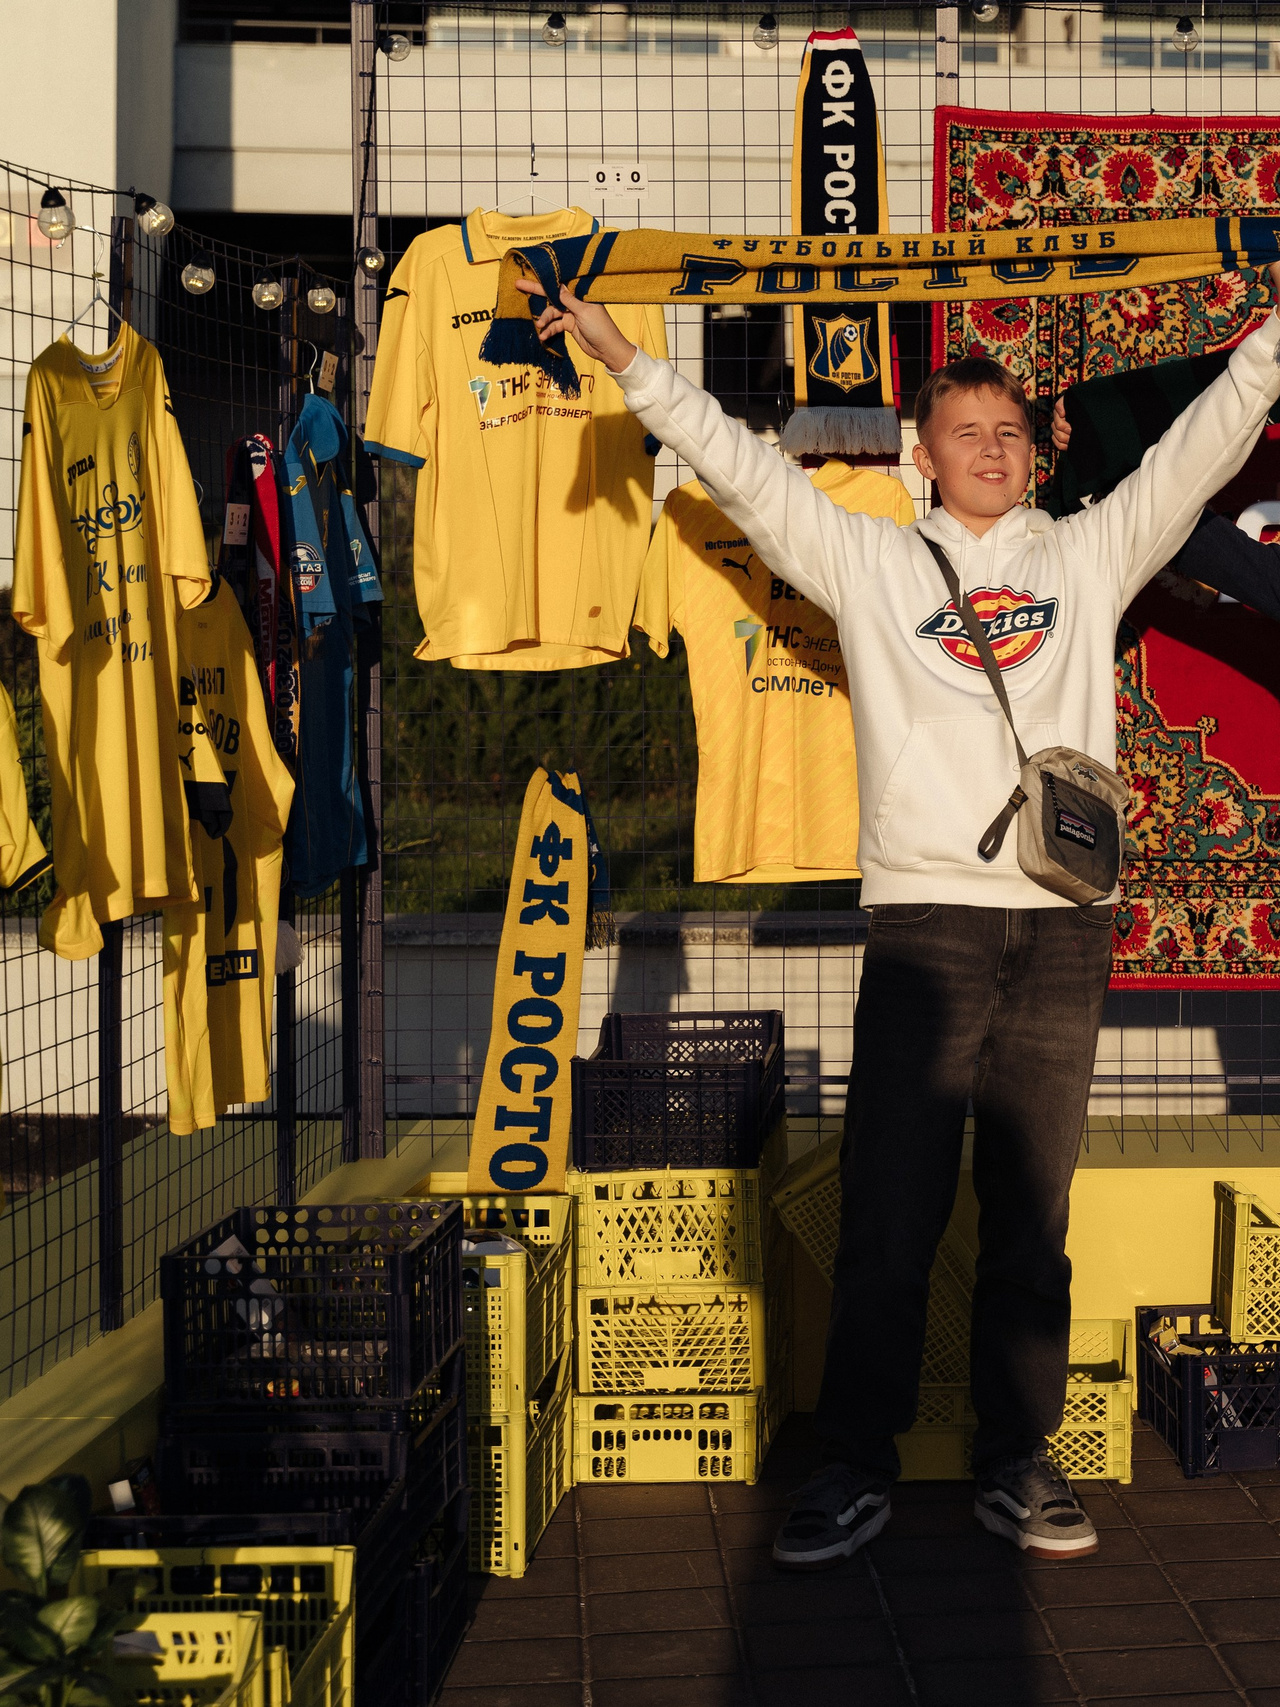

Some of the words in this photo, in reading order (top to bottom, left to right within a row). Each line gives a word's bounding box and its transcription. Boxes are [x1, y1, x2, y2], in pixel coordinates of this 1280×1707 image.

[822, 60, 855, 128] ФК
[596, 171, 606, 183] 0
[631, 171, 641, 183] 0
[823, 144, 857, 235] РОС
[711, 233, 987, 259] ФУТБОЛЬНЫЙ
[1015, 231, 1116, 254] КЛУБ
[495, 371, 531, 399] ТНС
[535, 369, 595, 394] ЭНГО
[535, 405, 593, 420] РСТОВЭНЕРГО
[704, 537, 752, 551] ЮгСтройИ
[934, 610, 1046, 639] Dkies
[766, 625, 803, 649] ТНС
[803, 634, 842, 654] ЭНЕР
[1060, 823, 1095, 846] patagonia
[519, 820, 573, 926] ФК
[488, 949, 567, 1191] РОСТО
